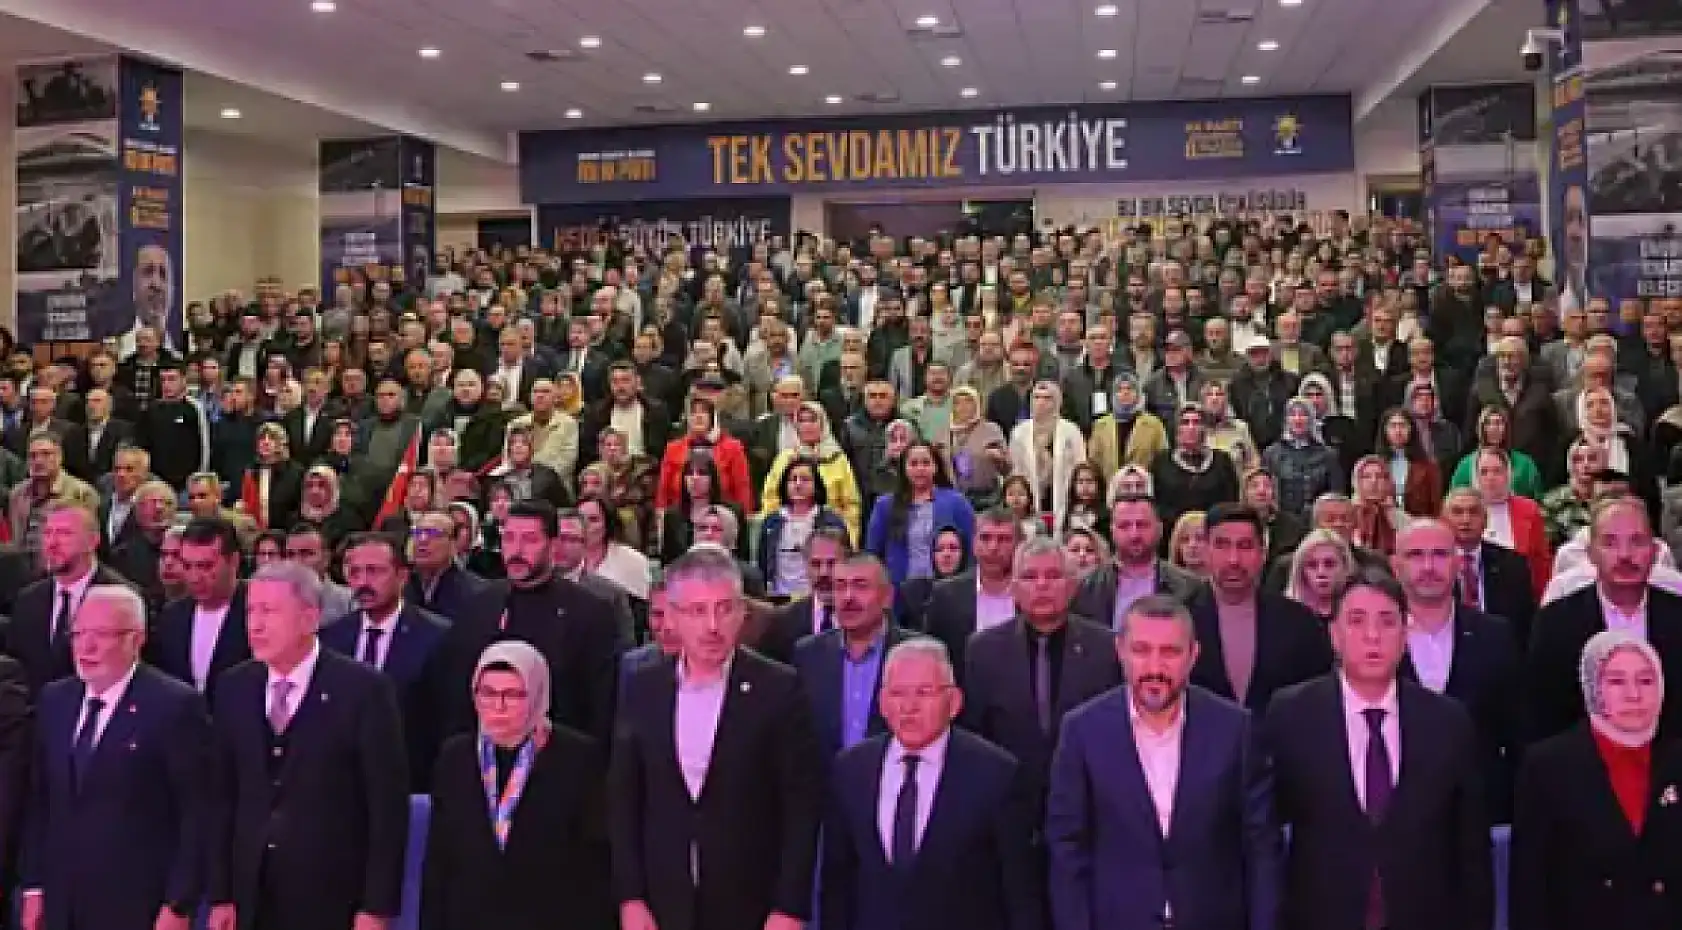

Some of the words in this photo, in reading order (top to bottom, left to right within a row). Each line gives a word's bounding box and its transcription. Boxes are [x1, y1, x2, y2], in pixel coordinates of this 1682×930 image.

[708, 134, 774, 183] TEK
[783, 126, 962, 182] SEVDAMIZ
[968, 110, 1128, 175] TÜRKİYE
